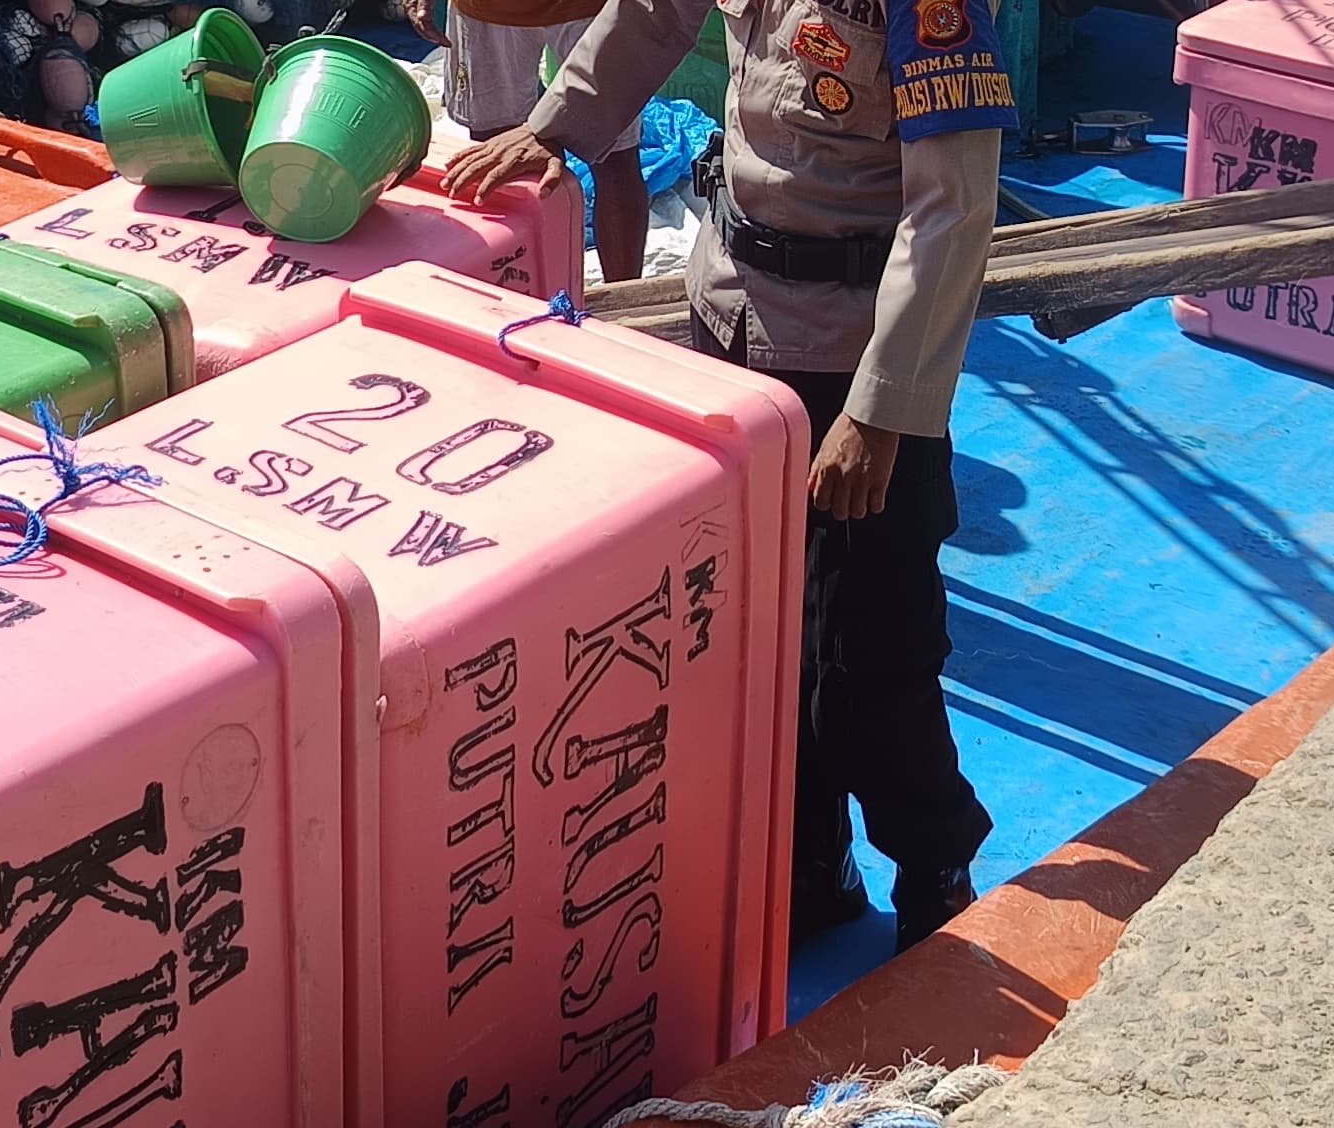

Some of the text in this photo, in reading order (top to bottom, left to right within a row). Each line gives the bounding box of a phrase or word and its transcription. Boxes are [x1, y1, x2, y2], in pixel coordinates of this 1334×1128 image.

[902, 52, 995, 78] BINMAS AIR
[1248, 126, 1319, 175] KM
[281, 372, 556, 495] 20
[444, 636, 518, 1017] PUTRA
[175, 826, 250, 1006] KM
